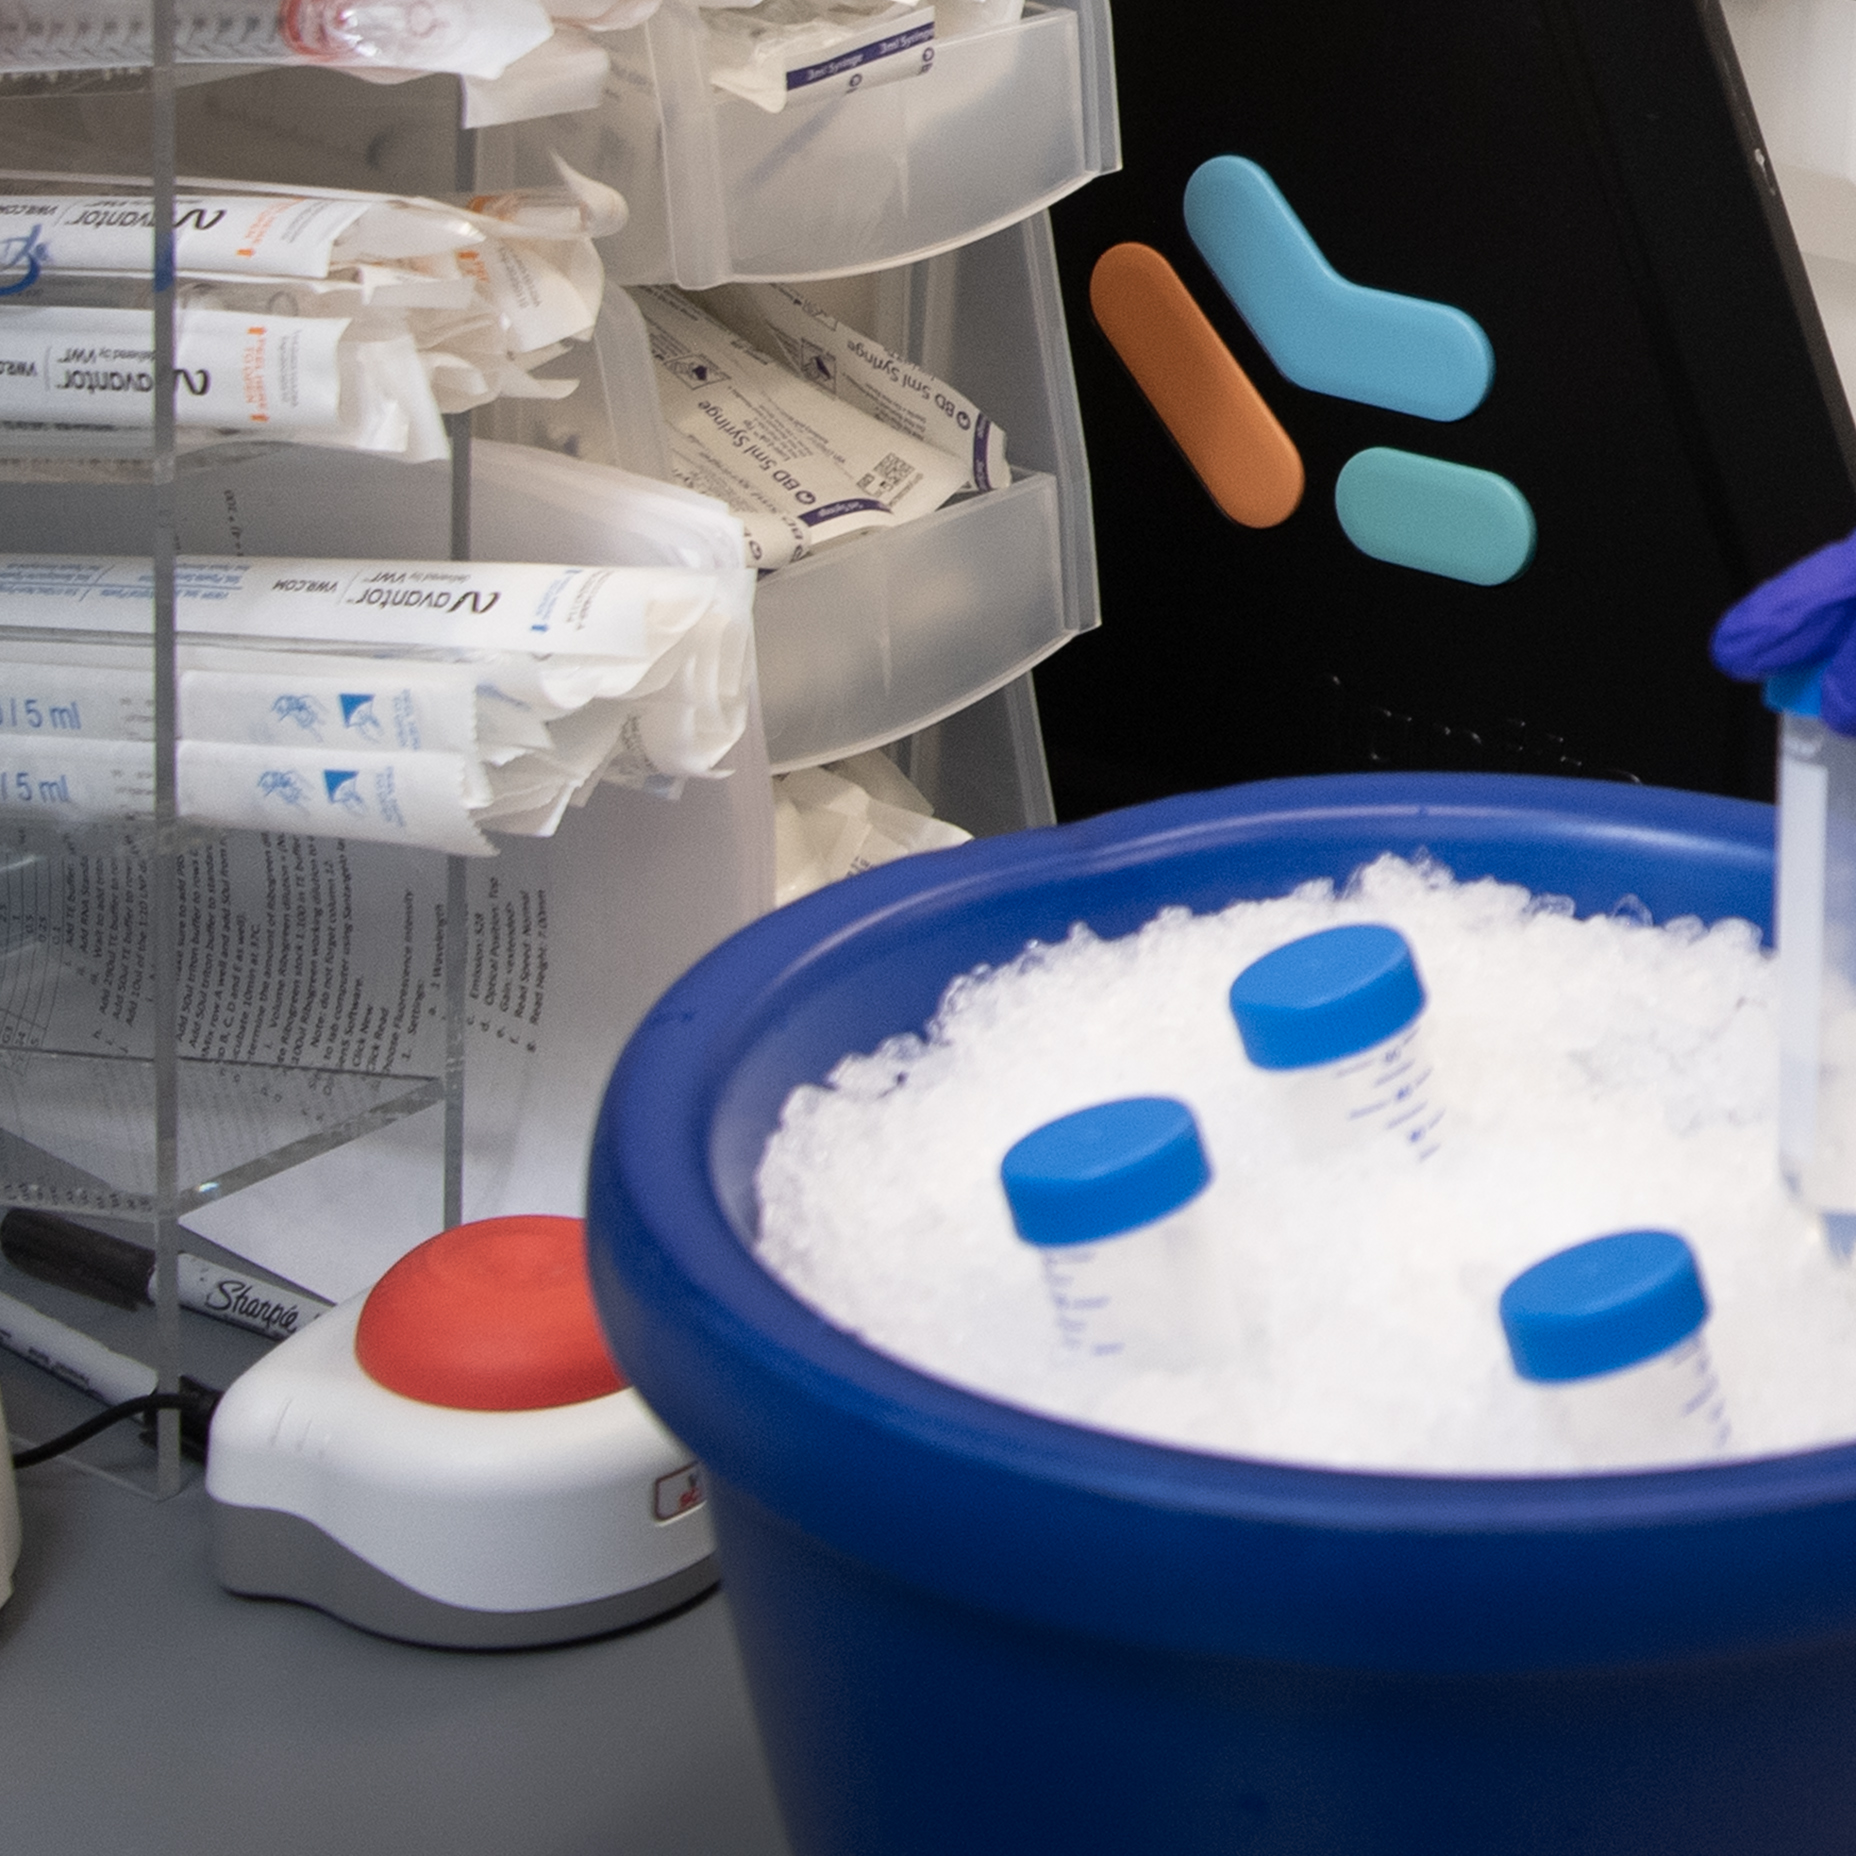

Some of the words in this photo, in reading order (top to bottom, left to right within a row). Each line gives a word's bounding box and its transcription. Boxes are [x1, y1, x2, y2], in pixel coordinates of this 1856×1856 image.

[826, 52, 864, 73] Syringe
[844, 339, 900, 387] Syringe
[58, 369, 155, 395] avantor
[901, 372, 931, 402] 5ml
[932, 392, 956, 419] BD
[697, 400, 750, 448] Syringe
[743, 443, 777, 472] 5ml
[771, 470, 800, 491] BD
[272, 578, 339, 596] VWR.COM
[354, 588, 452, 610] avantor
[25, 698, 44, 729] 5
[50, 700, 83, 731] ml
[15, 771, 33, 803] 5
[39, 774, 71, 804] ml
[205, 1279, 300, 1334] Sharpie
